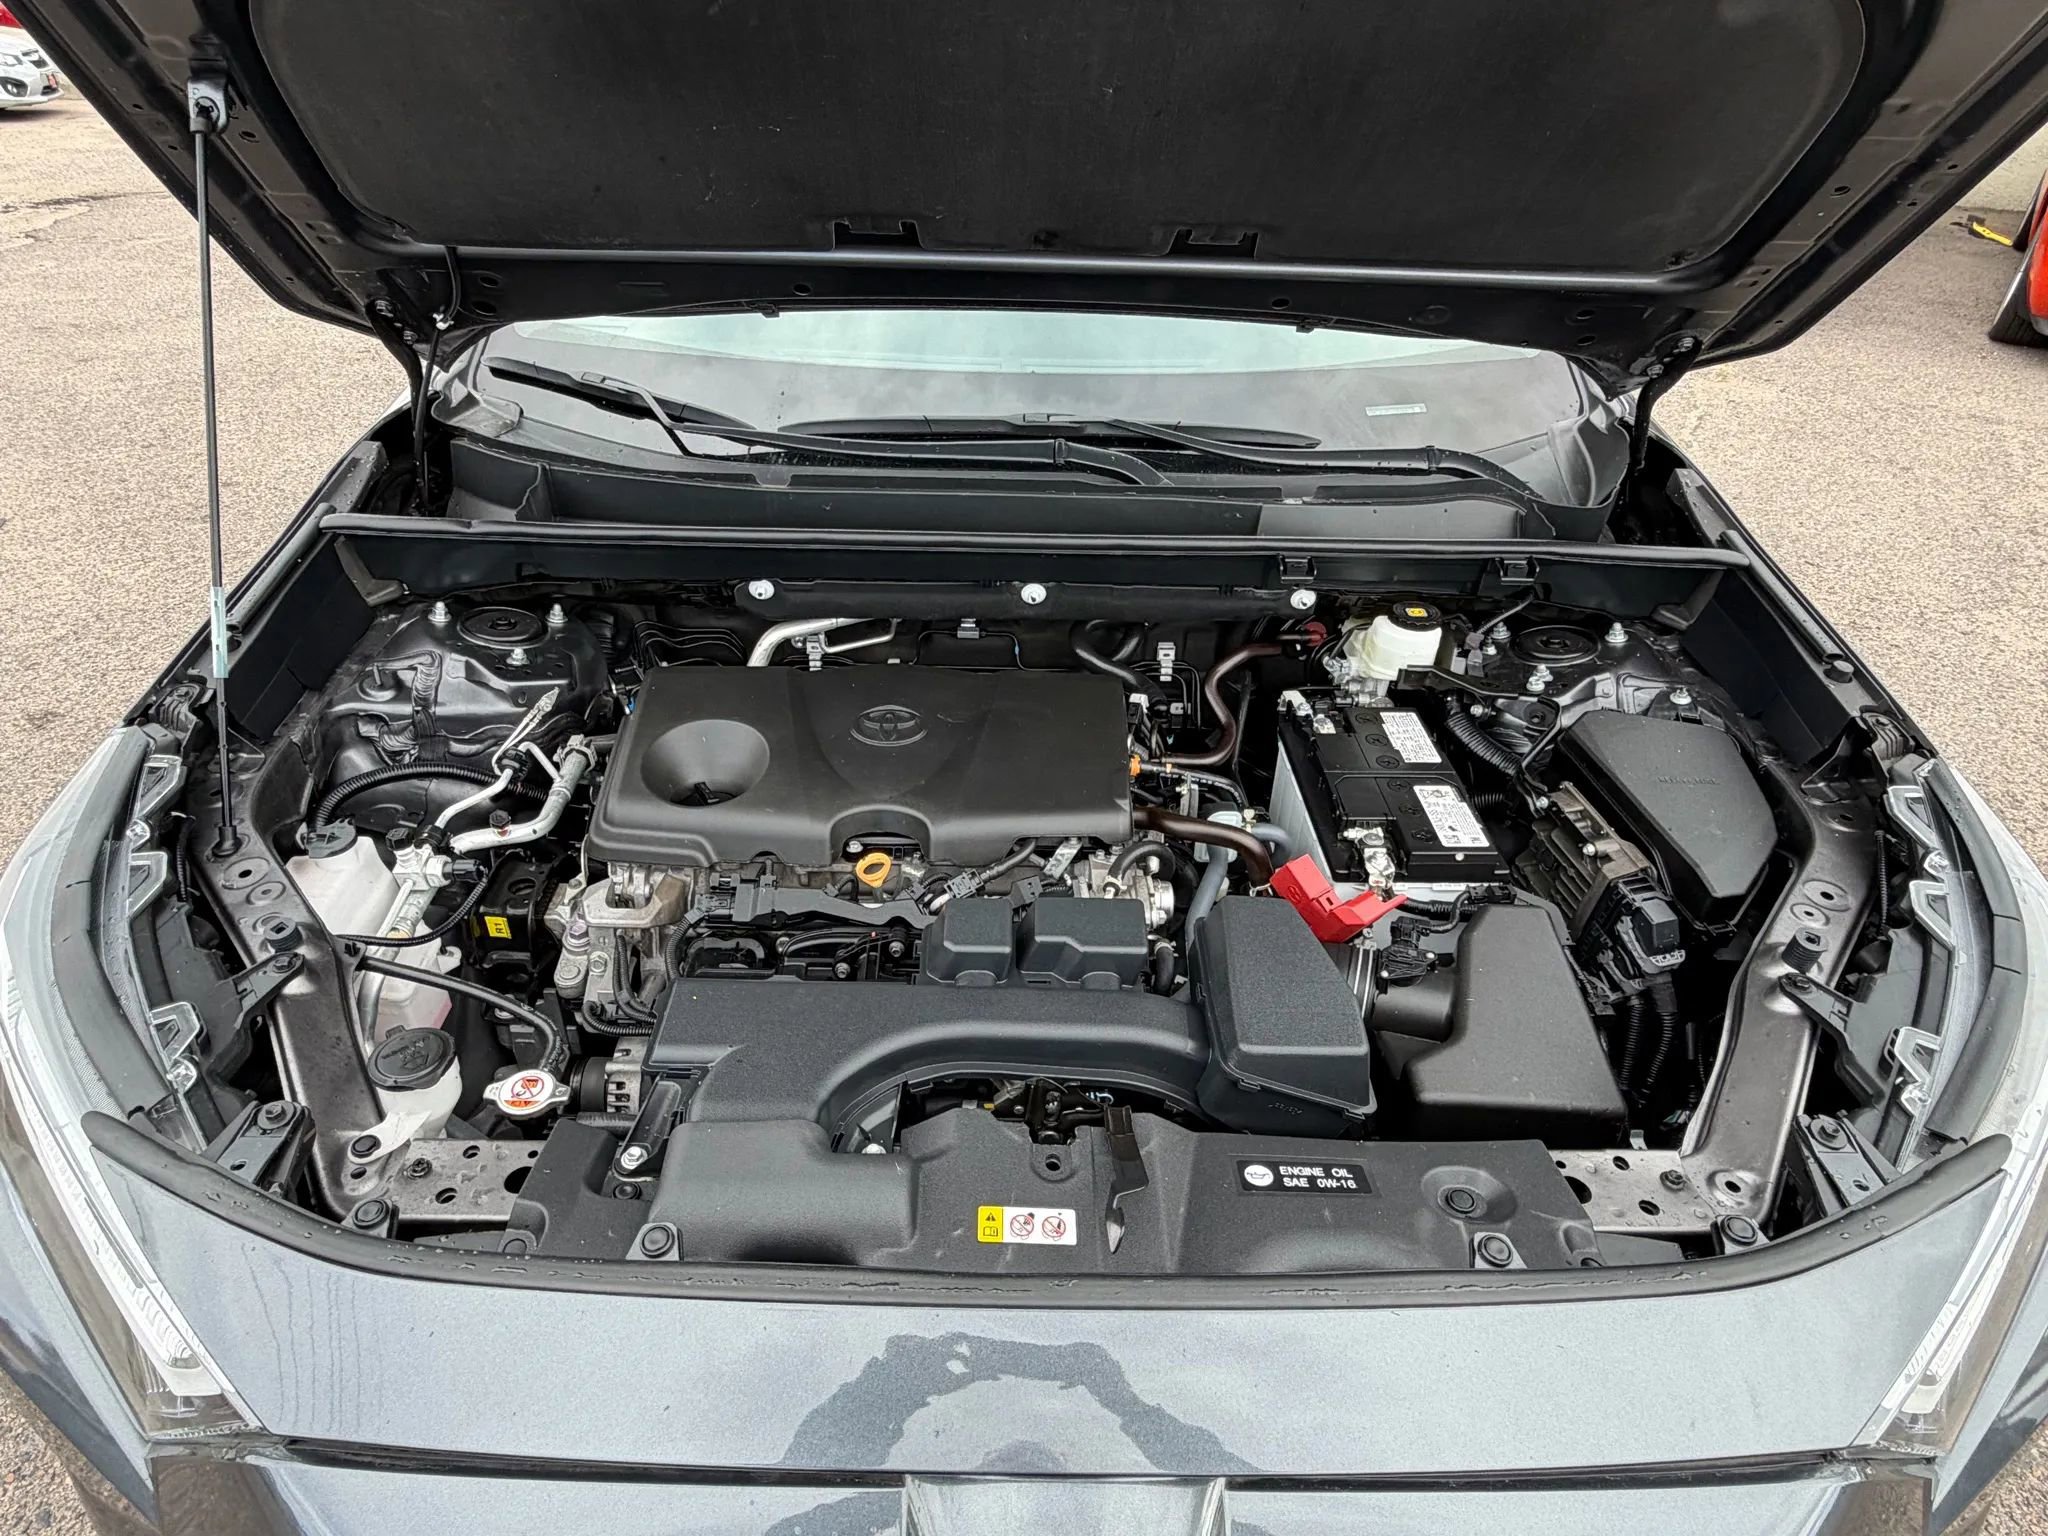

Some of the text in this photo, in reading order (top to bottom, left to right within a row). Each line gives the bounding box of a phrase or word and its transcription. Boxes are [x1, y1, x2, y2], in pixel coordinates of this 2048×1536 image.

[1279, 1166, 1353, 1177] ENGINE OIL
[1283, 1178, 1358, 1189] SAE 0W-16
